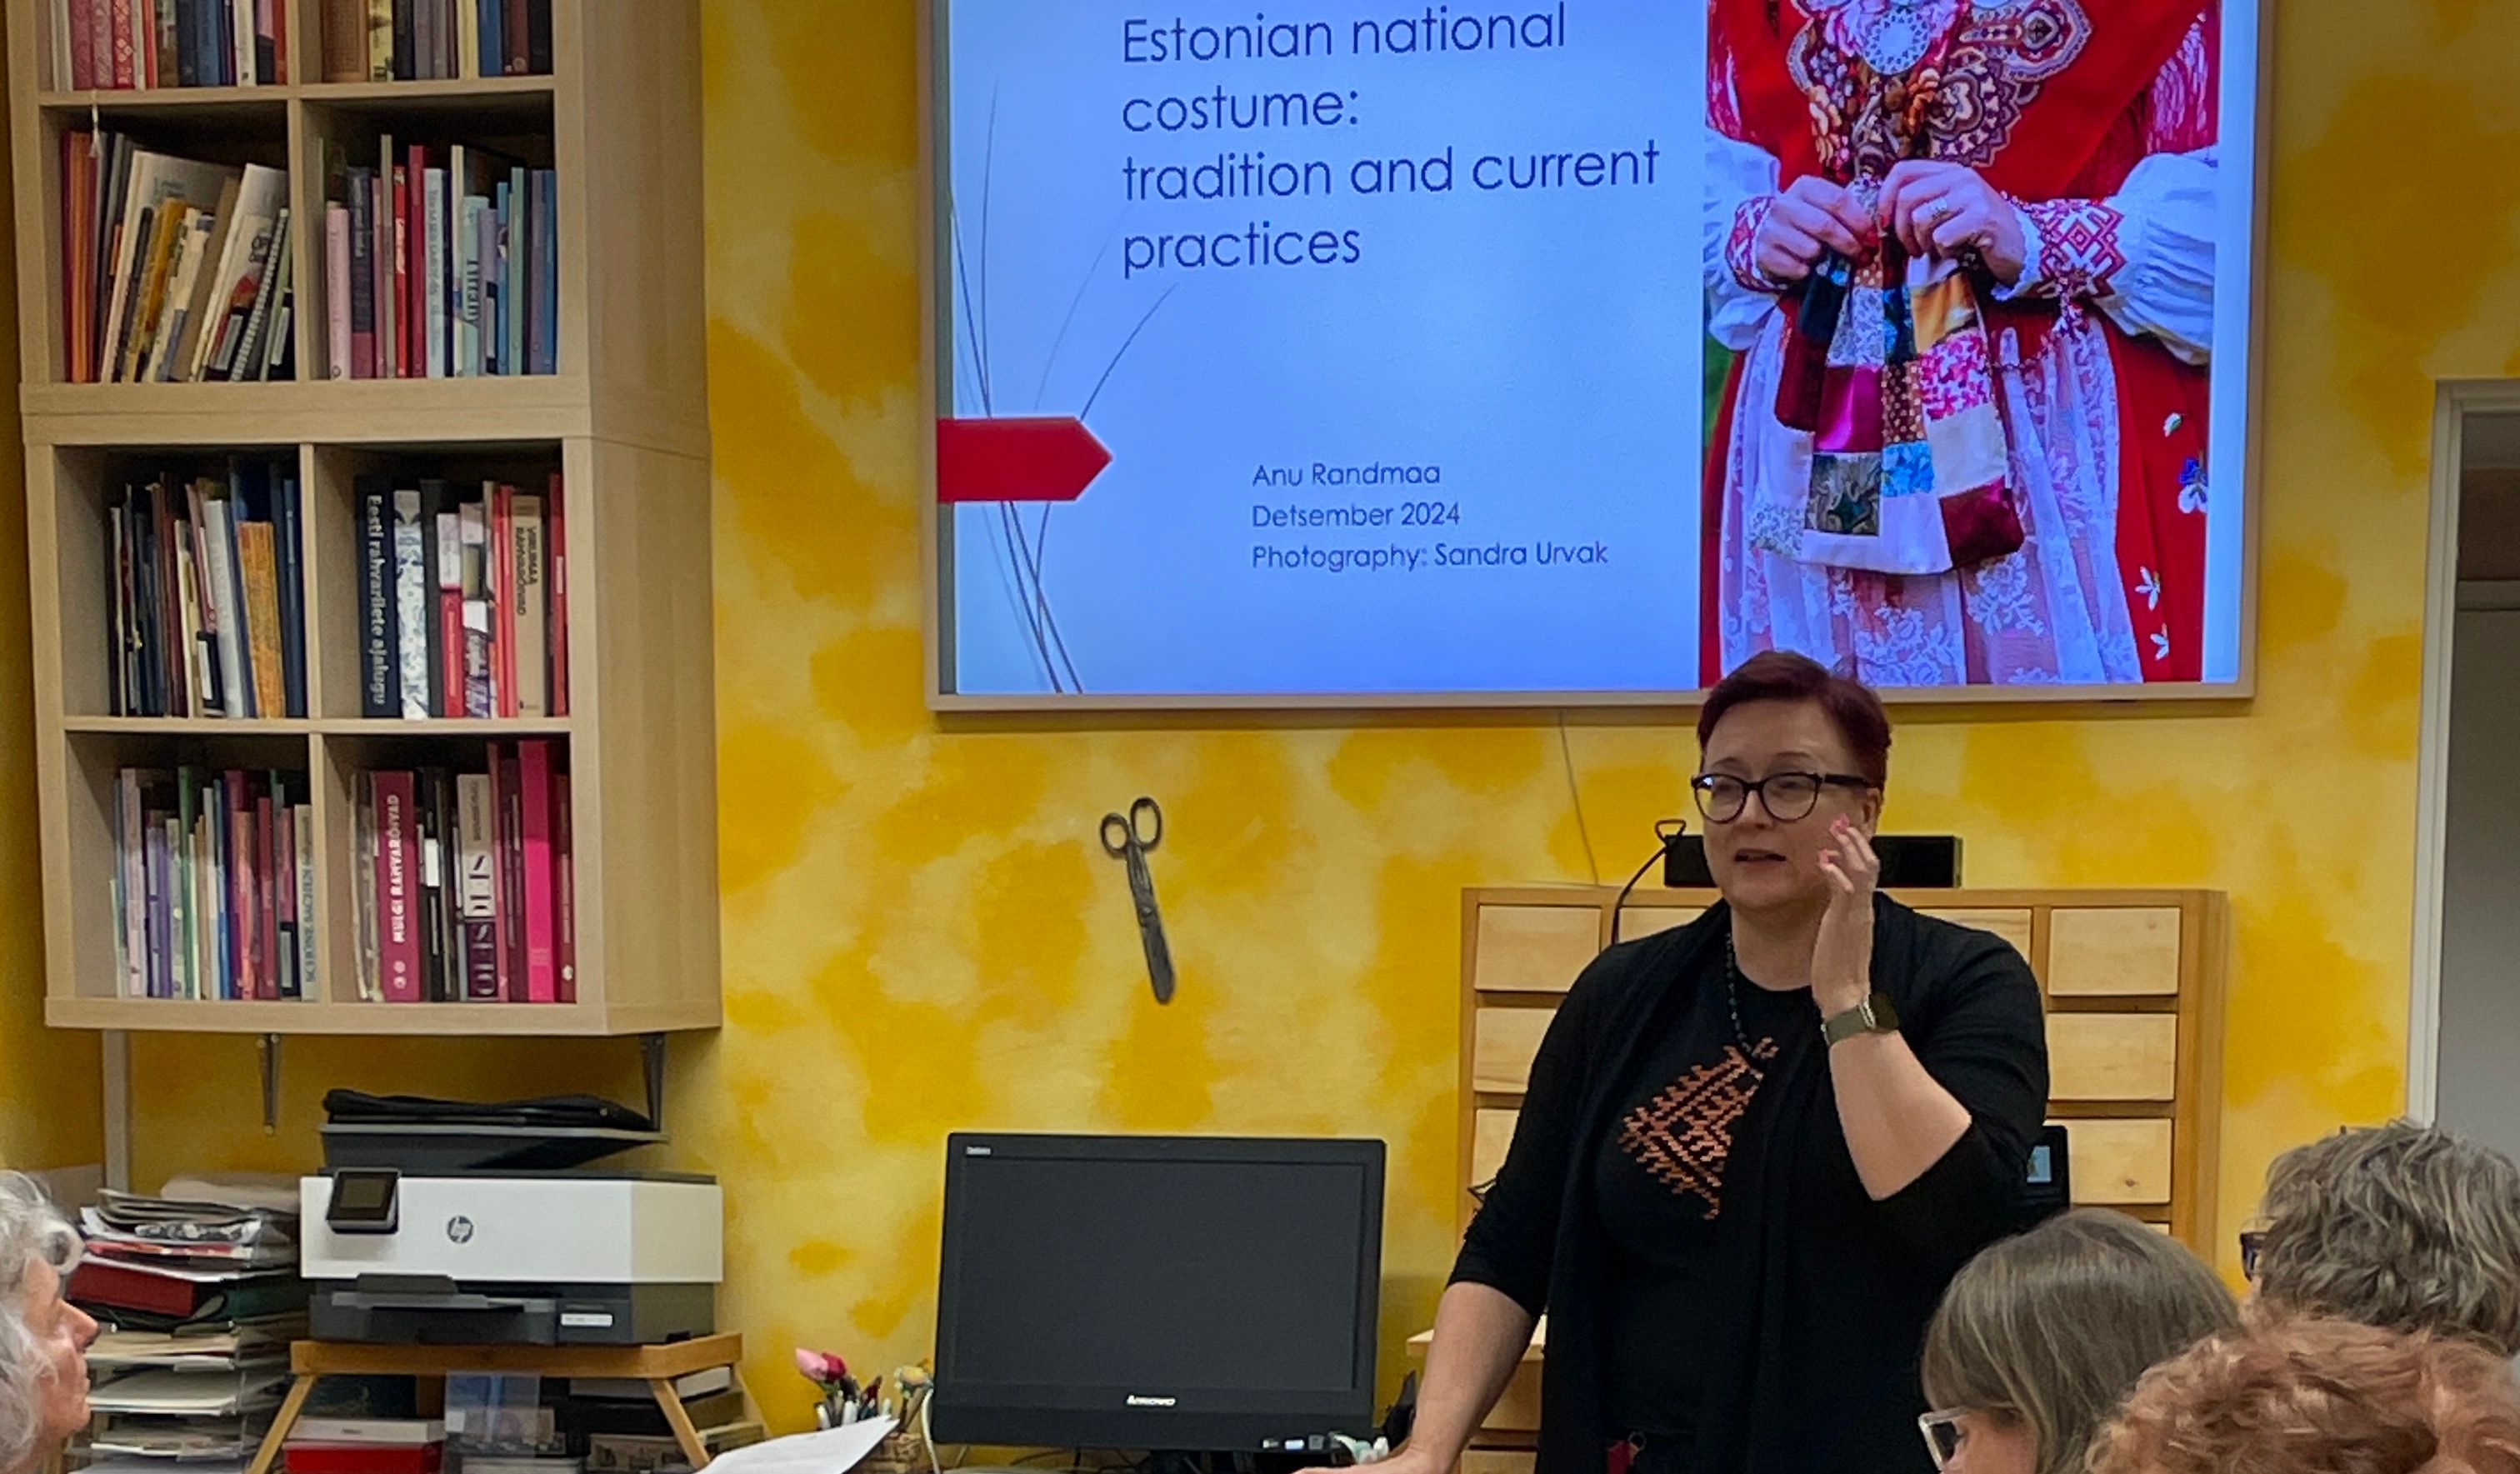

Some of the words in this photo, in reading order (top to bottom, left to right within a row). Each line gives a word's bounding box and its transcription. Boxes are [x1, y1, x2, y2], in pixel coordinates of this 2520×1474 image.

[1123, 12, 1332, 63] Estonian
[1352, 1, 1565, 55] national
[1122, 84, 1358, 132] costume:
[1122, 150, 1332, 202] tradition
[1350, 145, 1453, 195] and
[1472, 139, 1660, 191] current
[1124, 220, 1362, 280] practices
[1252, 464, 1303, 487] Anu
[1312, 462, 1441, 486] Randmaa
[368, 495, 384, 537] Eesti
[1252, 503, 1394, 527] Detsember
[1401, 501, 1461, 527] 2024
[1252, 542, 1428, 573] Photography:
[1433, 542, 1528, 567] Sandra
[1536, 541, 1608, 566] Urvak
[369, 638, 389, 705] ajalugu
